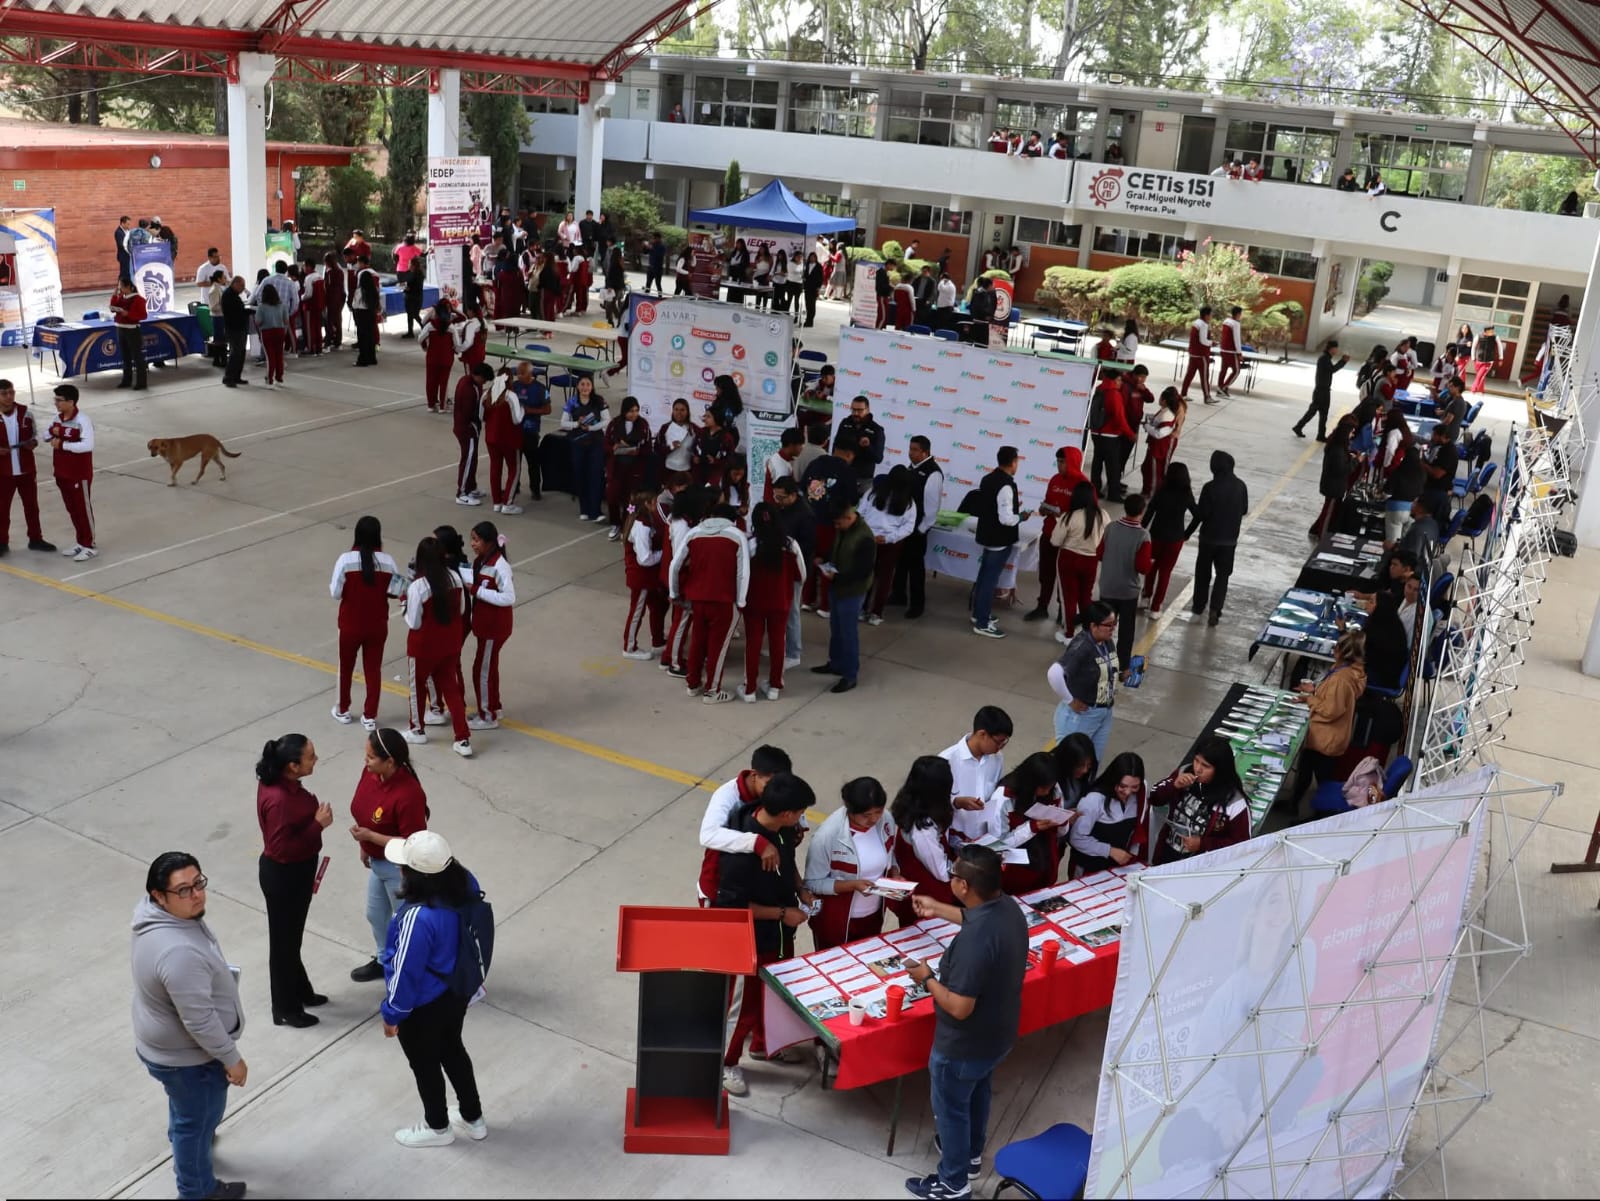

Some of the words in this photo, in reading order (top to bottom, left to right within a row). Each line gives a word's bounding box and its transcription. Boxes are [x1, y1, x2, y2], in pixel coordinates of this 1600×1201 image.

[430, 168, 455, 178] IEDEP
[1127, 172, 1184, 194] CETis
[1188, 178, 1215, 198] 151
[1148, 192, 1176, 204] Miguel
[1177, 195, 1212, 208] Negrete
[1161, 205, 1176, 214] Pue
[1380, 210, 1402, 233] C
[440, 226, 480, 238] TEPEACA
